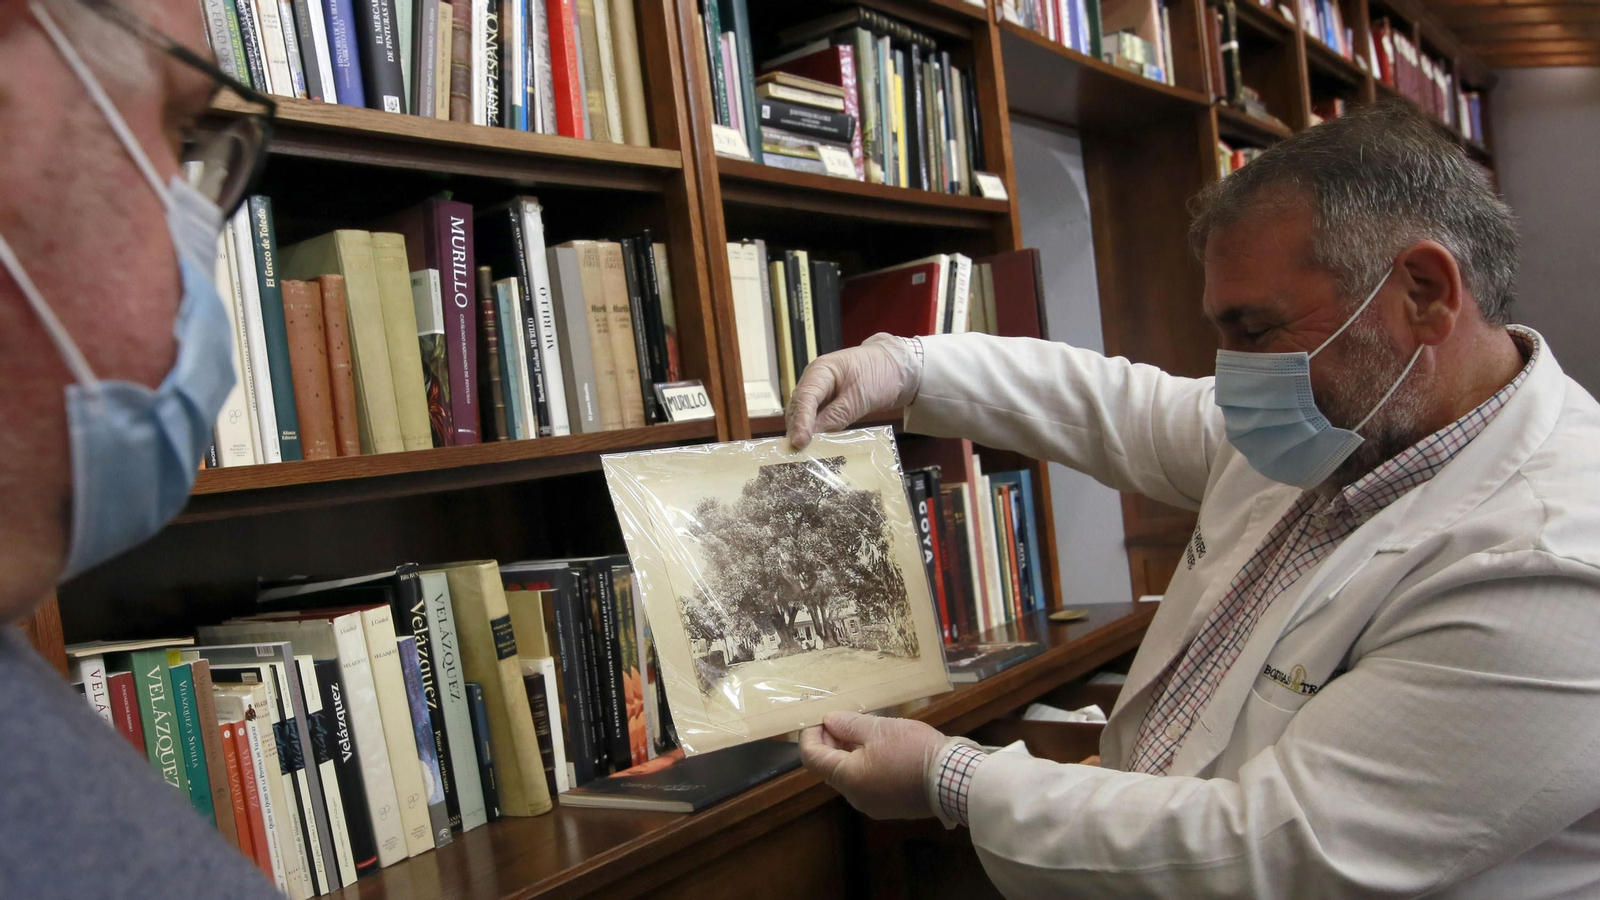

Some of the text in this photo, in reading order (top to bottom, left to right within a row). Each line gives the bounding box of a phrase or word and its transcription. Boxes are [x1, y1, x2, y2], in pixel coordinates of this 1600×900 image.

[213, 12, 226, 44] EDAD
[227, 12, 236, 37] CARLOS
[376, 34, 384, 44] EL
[382, 10, 394, 62] DE PINTURAS
[236, 48, 244, 77] PALACIO
[334, 36, 344, 66] HISTORIA
[488, 86, 499, 124] ARTE
[258, 208, 275, 288] El Greco de Toledo
[450, 216, 468, 308] MURILLO
[538, 287, 554, 350] MURILLO
[527, 317, 544, 402] Bartolomé Esteban MURILLO
[666, 392, 707, 412] MURILLO
[919, 502, 933, 563] GOYA
[602, 605, 608, 613] DE
[410, 598, 438, 710] Velázquez
[435, 593, 461, 702] VELÁZQUEZ
[606, 641, 611, 649] LA
[607, 651, 612, 659] EN
[611, 690, 616, 698] DE
[331, 683, 354, 764] Velázquez
[615, 728, 620, 738] UN
[435, 730, 444, 752] Pintor
[439, 760, 450, 793] cortesano
